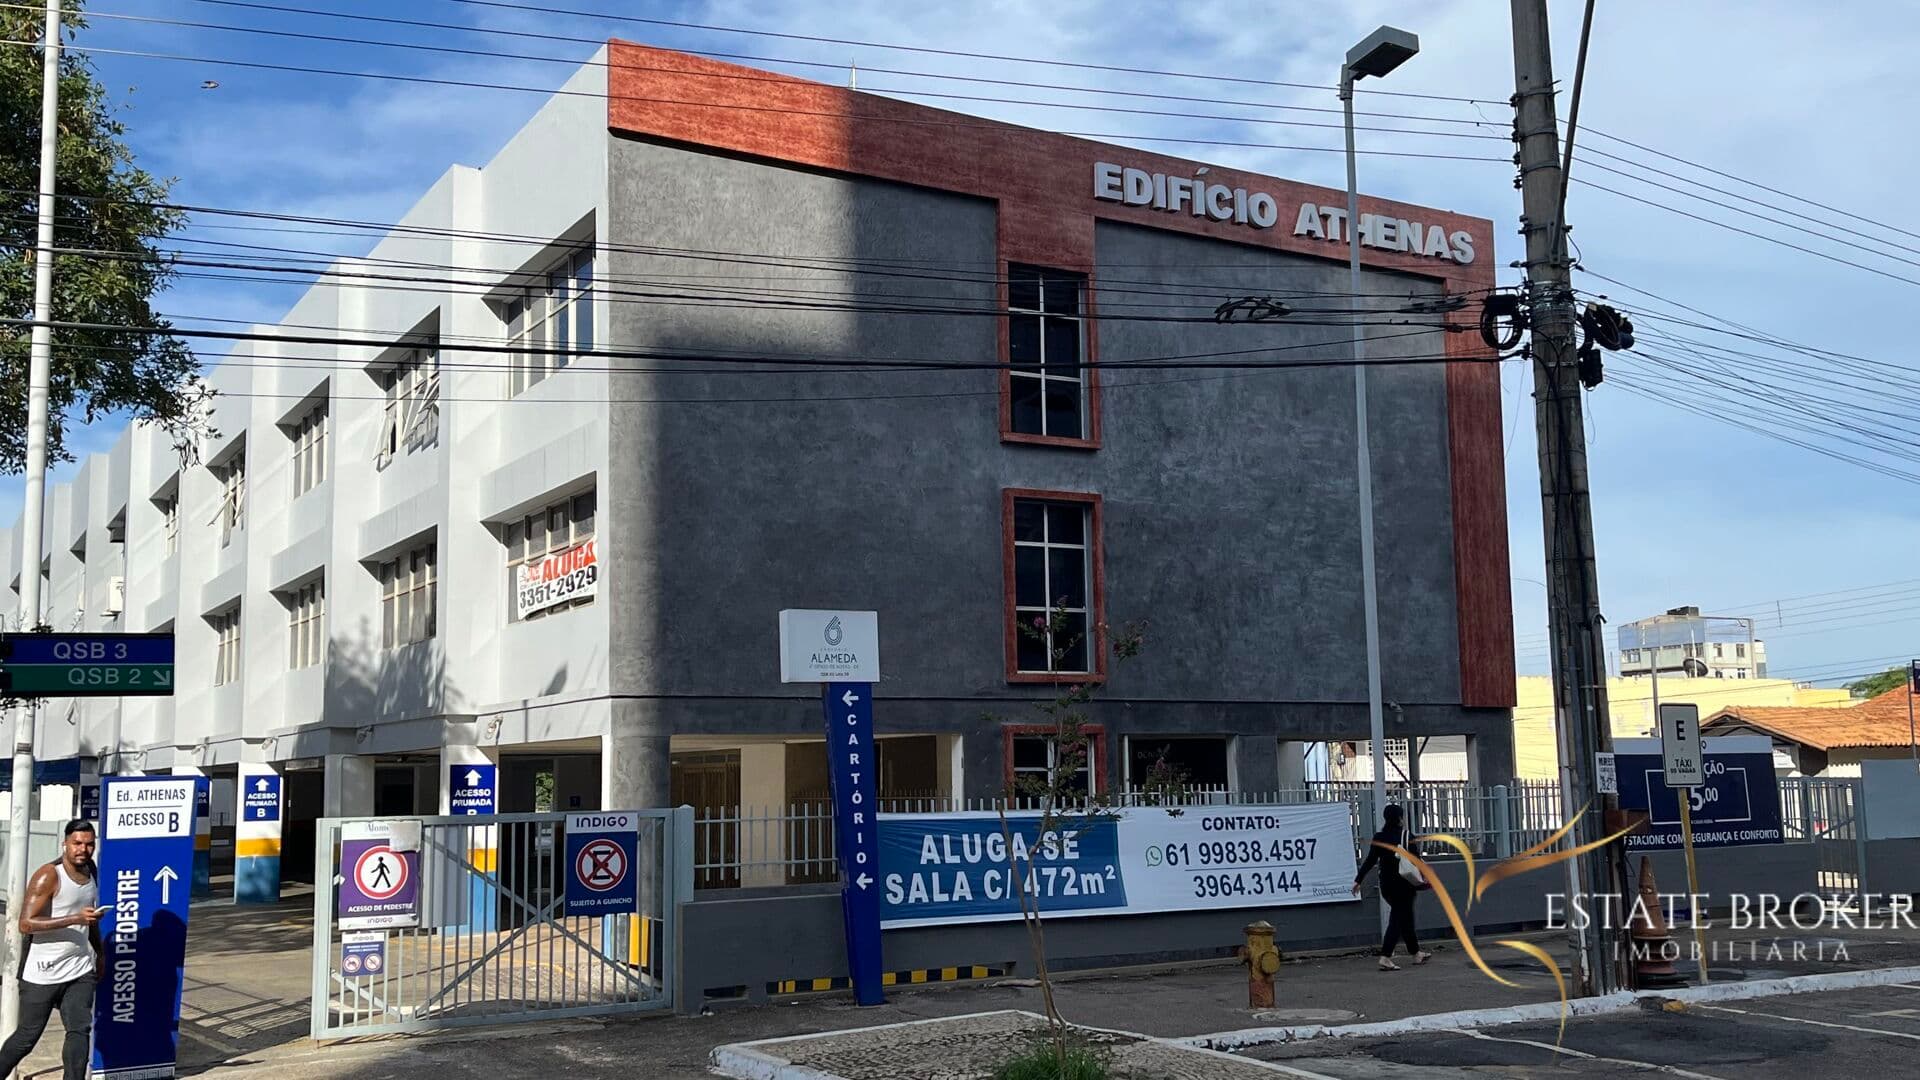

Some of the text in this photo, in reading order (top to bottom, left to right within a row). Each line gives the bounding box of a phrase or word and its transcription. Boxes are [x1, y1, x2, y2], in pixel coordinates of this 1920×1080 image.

[1093, 161, 1475, 265] EDIFÍCIO ATHENAS
[541, 541, 597, 583] ALUGA
[519, 565, 597, 609] 3351-2929
[53, 642, 128, 660] QSB 3
[811, 653, 857, 663] ALAMEDA
[68, 668, 141, 685] QSB 2
[1676, 720, 1686, 741] E
[116, 790, 133, 801] Ed.
[137, 789, 186, 801] ATHENAS
[247, 792, 277, 800] ACESSO
[454, 788, 491, 797] ACESSO
[847, 714, 867, 864] CARTÓRIO
[452, 798, 492, 807] PRUMADA
[257, 808, 266, 817] B
[118, 812, 179, 833] ACESSO B
[576, 816, 628, 828] INDIGO
[1202, 816, 1280, 831] CONTATO:
[1691, 831, 1733, 844] EGURANÇA
[1734, 831, 1739, 841] E
[1740, 829, 1779, 840] CONFORTO
[1165, 838, 1317, 866] 61 99838.4587
[885, 871, 973, 905] SALA
[983, 868, 1011, 900] C/
[1193, 870, 1302, 898] 3964.3144
[347, 905, 372, 913] ACESSO
[383, 902, 414, 910] PEDESTRE
[570, 899, 595, 907] SUJEITO
[602, 897, 633, 905] GUINCHO
[112, 869, 140, 1023] ACESSO PEDESTRE
